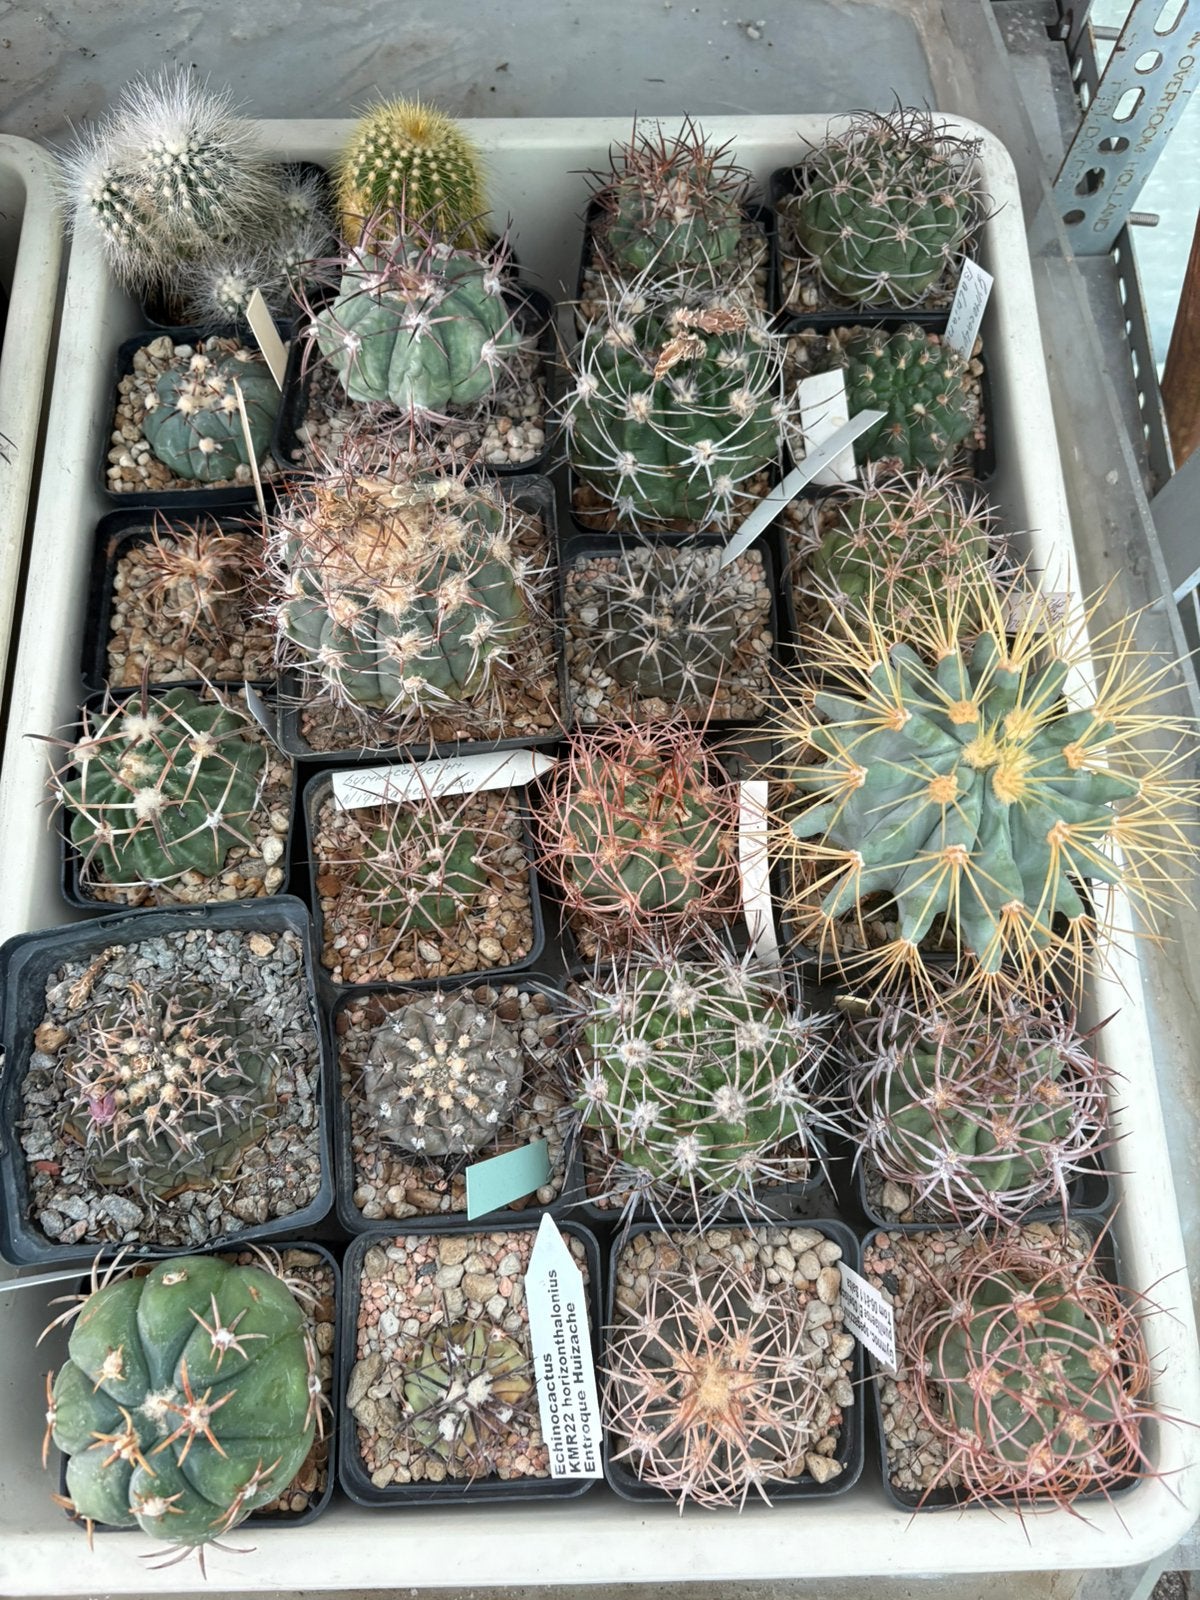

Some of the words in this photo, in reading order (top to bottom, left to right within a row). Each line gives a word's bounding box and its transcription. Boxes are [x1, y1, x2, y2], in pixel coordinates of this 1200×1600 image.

[1092, 160, 1140, 234] HOLLAND
[547, 1269, 573, 1407] horizonthalonius
[566, 1302, 584, 1384] Huizache
[543, 1353, 566, 1475] Echinocactus
[563, 1413, 581, 1473] KMR22
[577, 1390, 596, 1472] Entroque
